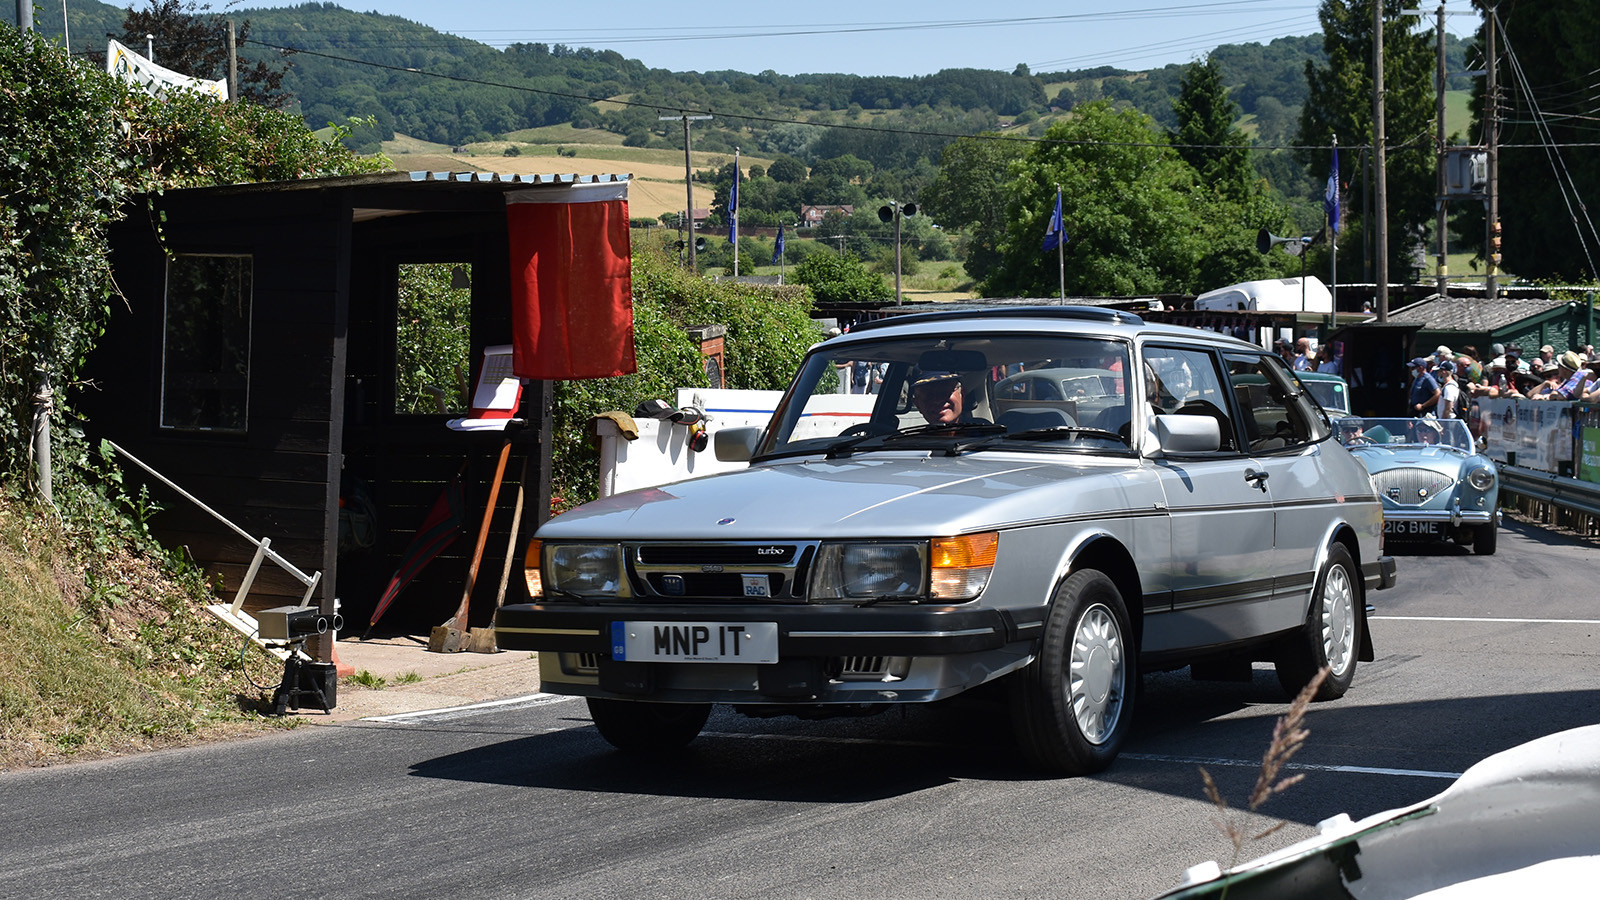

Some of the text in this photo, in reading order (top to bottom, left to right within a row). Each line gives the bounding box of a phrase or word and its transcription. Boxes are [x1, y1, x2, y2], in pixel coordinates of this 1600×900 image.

[1384, 521, 1438, 534] 216 BME
[757, 546, 785, 555] turbo
[746, 586, 765, 595] RAC
[653, 625, 710, 656] MNP
[614, 646, 624, 654] GB
